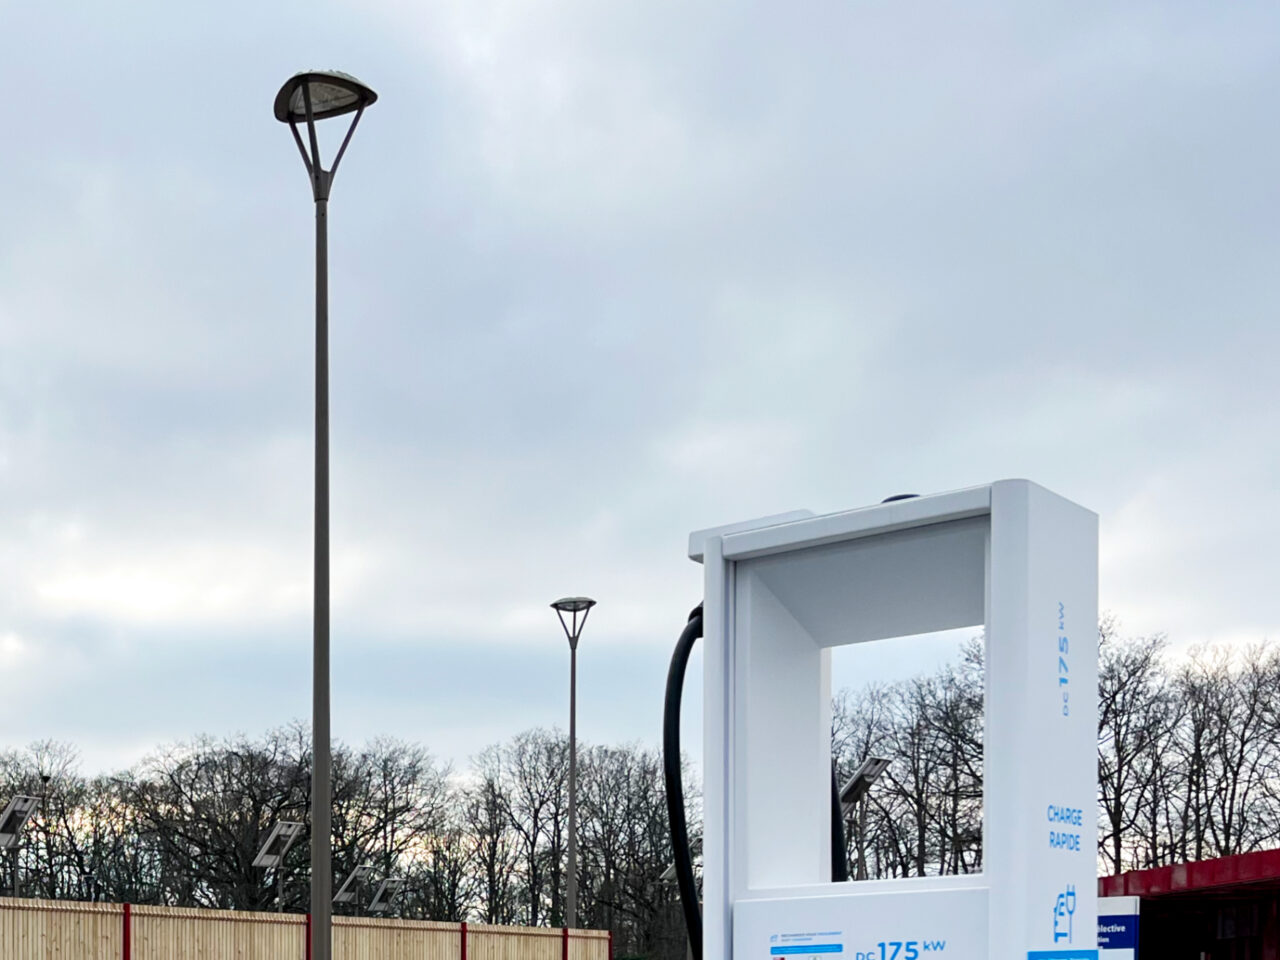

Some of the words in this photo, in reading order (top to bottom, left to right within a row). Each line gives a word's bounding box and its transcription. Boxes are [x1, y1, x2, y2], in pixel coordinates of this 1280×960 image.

[1058, 636, 1069, 687] 175
[1047, 804, 1083, 826] CHARGE
[1049, 832, 1080, 851] RAPIDE
[923, 940, 947, 951] kW
